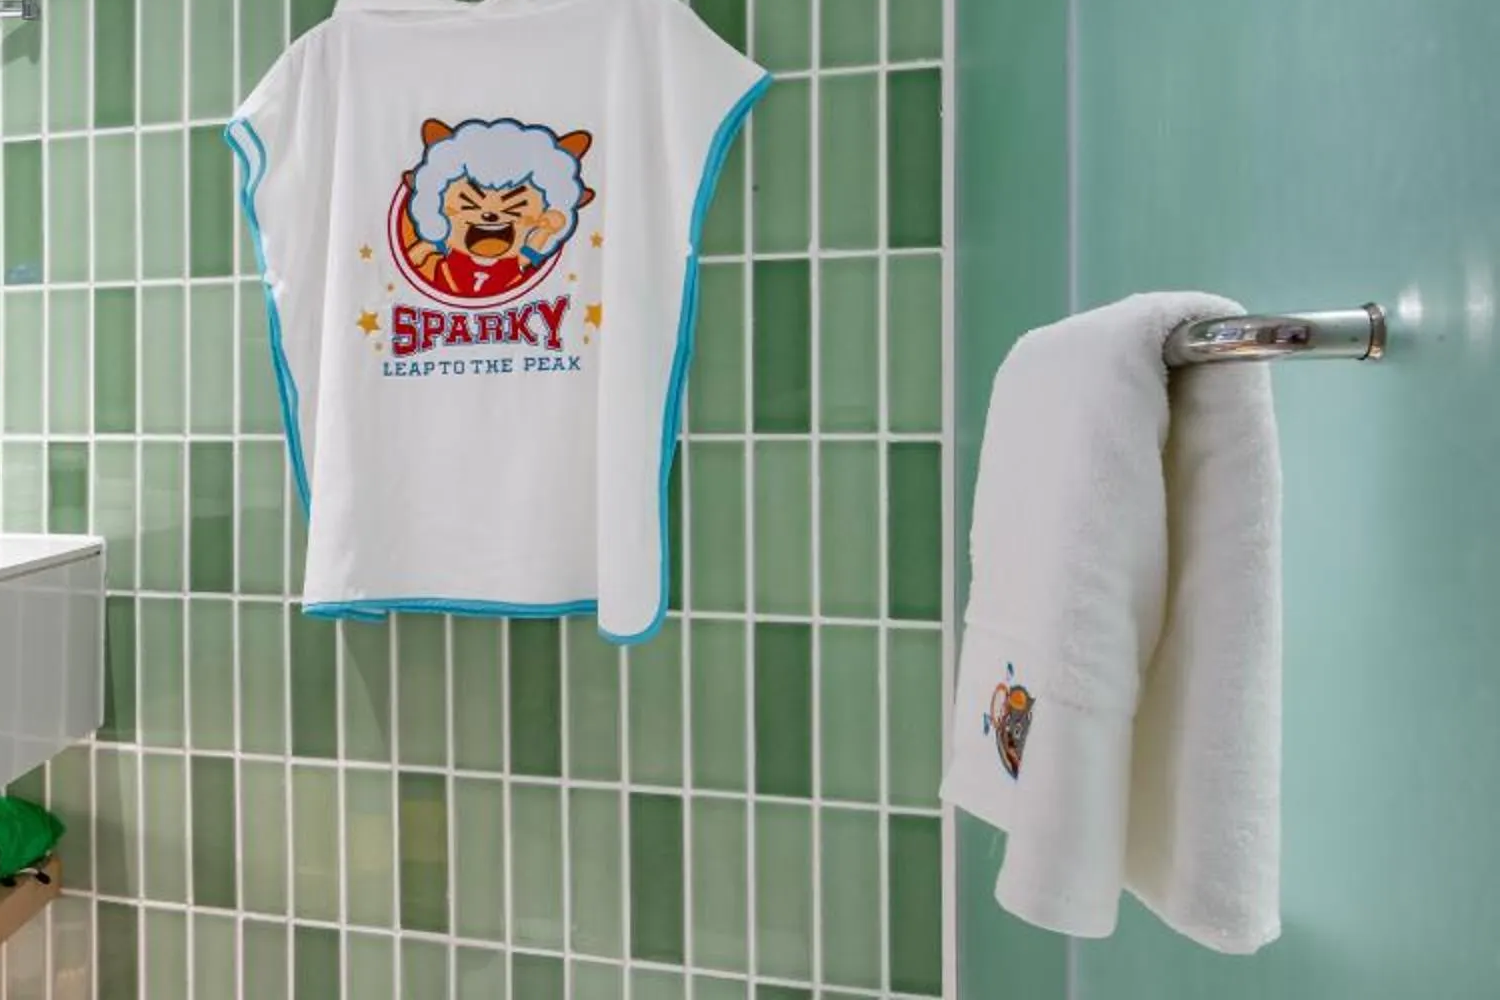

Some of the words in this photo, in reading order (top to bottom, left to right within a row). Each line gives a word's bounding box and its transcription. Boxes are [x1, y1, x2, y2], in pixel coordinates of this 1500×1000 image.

[392, 294, 571, 357] SPARKY
[383, 361, 435, 377] LEAP
[438, 360, 465, 375] TO
[470, 359, 513, 374] THE
[523, 356, 581, 371] PEAK
